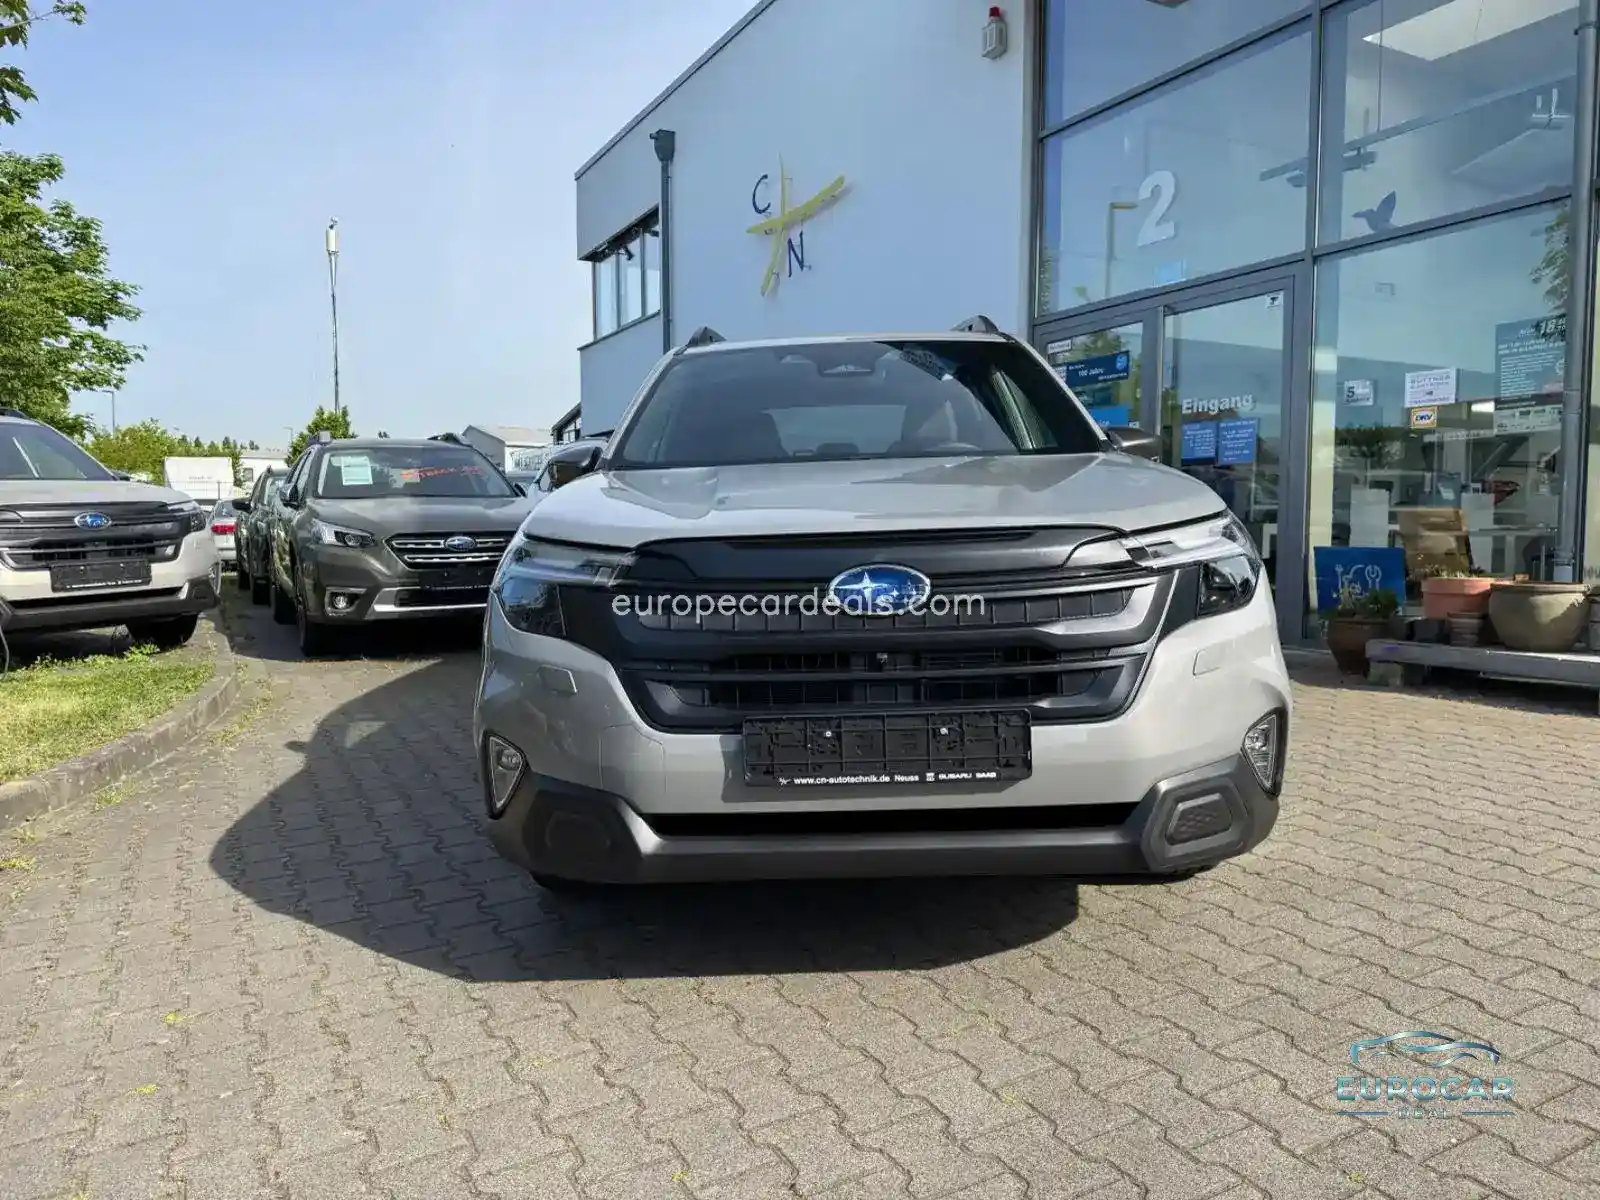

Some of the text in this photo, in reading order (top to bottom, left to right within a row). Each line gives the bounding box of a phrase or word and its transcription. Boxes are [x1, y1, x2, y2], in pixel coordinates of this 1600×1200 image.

[752, 173, 771, 214] C
[1137, 170, 1178, 247] 2
[787, 230, 805, 278] N
[1181, 394, 1256, 415] Eingang
[793, 774, 890, 785] www.cn-autotechnik.de
[894, 774, 920, 782] Neuss
